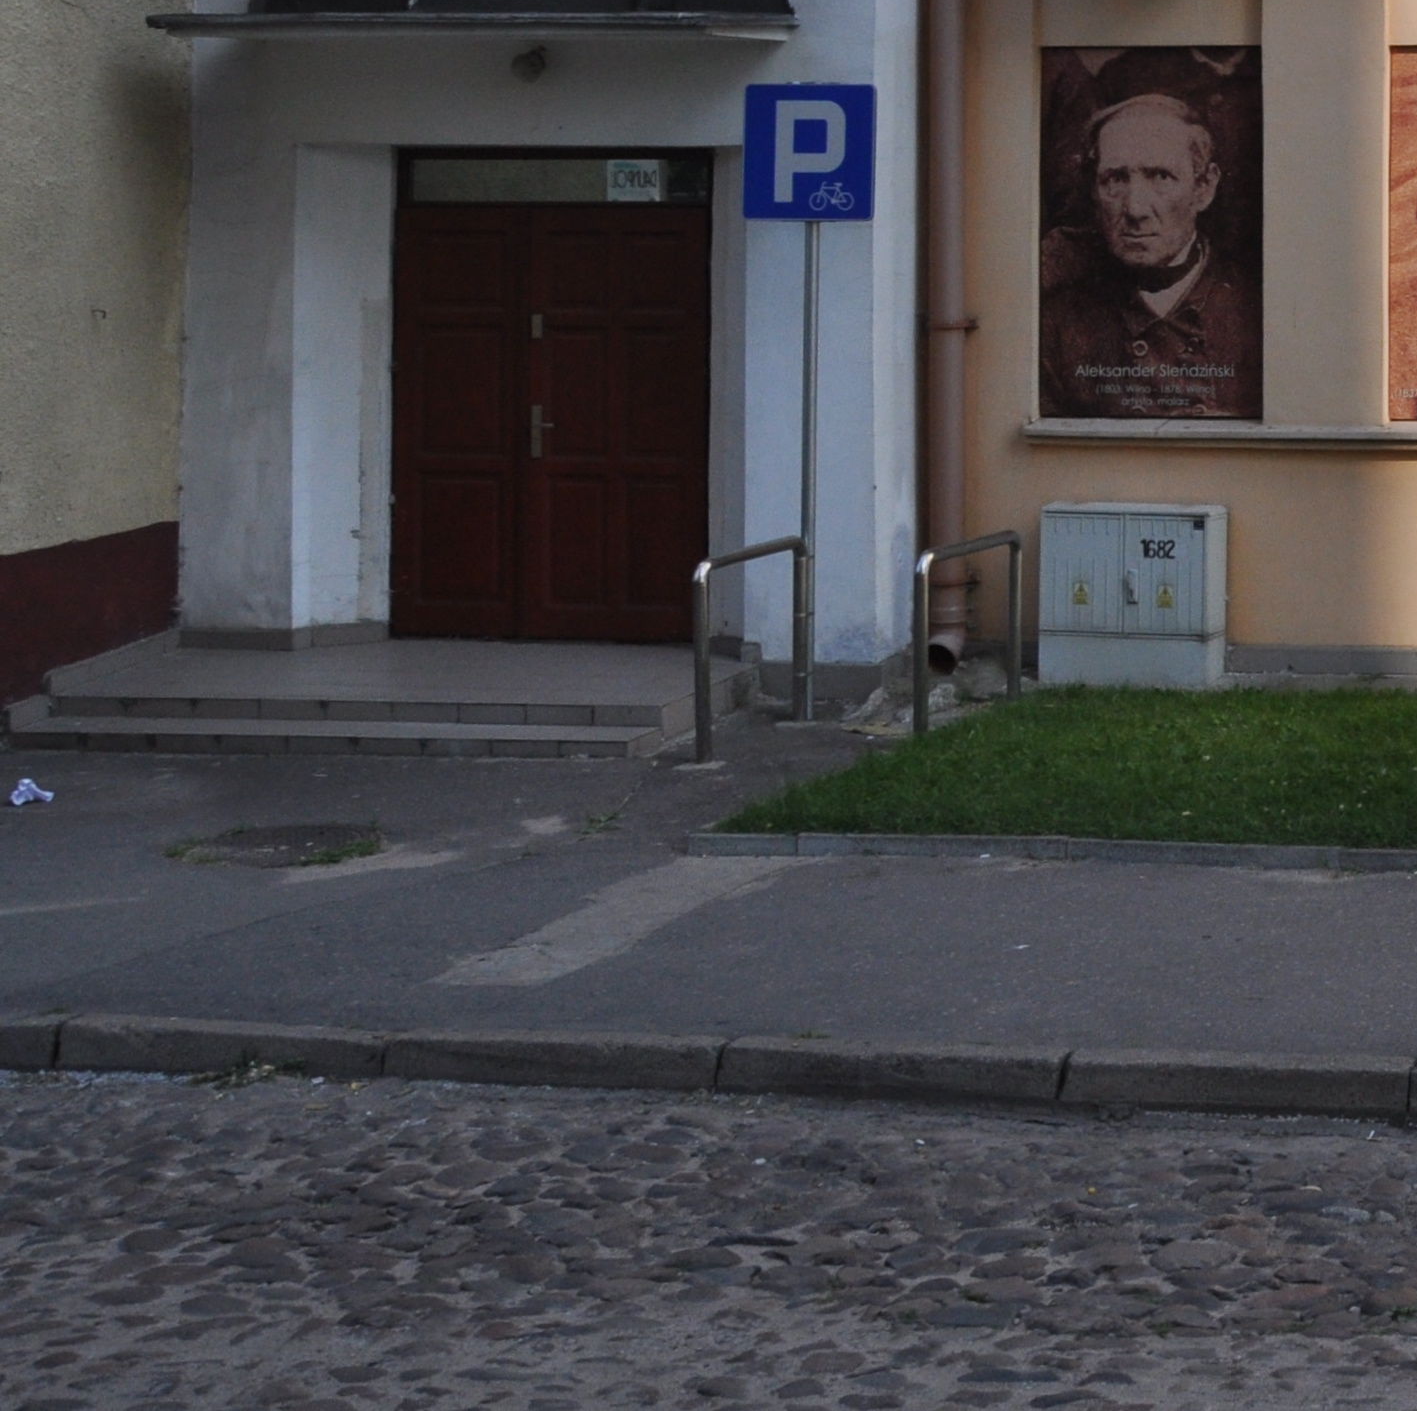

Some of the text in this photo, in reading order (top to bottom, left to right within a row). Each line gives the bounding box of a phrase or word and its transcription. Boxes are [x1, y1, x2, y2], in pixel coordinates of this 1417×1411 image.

[774, 99, 847, 203] P
[1074, 363, 1235, 378] Aleksander Sleńdziński
[1140, 538, 1176, 559] 1682
